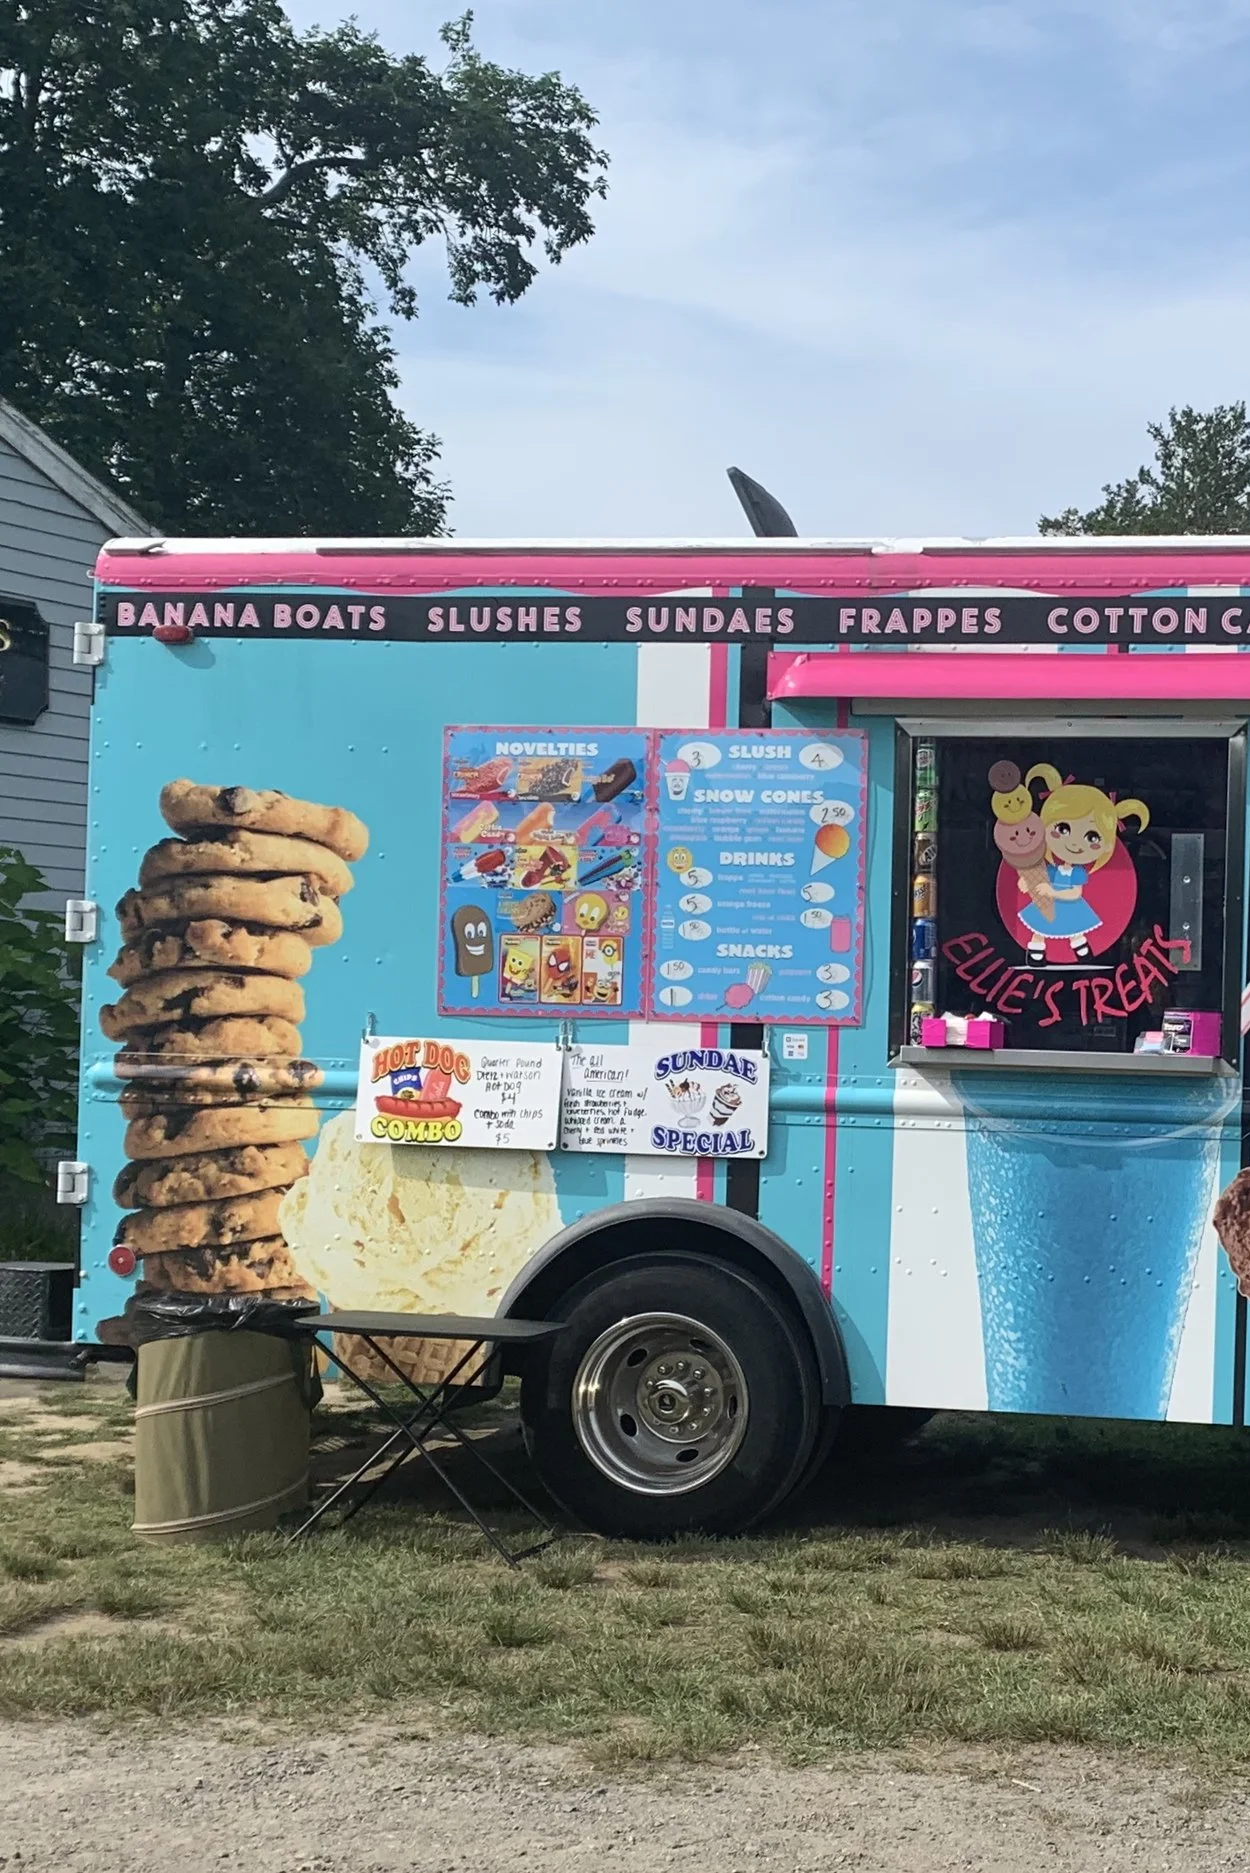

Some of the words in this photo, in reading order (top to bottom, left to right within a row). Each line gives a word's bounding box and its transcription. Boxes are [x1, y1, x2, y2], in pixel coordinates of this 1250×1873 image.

[117, 602, 260, 628] BANANA
[273, 604, 385, 631] BOATS
[427, 606, 582, 633] SLUSHES
[625, 607, 795, 634] SUNDAES
[839, 607, 1001, 634] FRAPPES
[1047, 607, 1207, 635] COTTON
[496, 742, 599, 757] NOVELTIES
[728, 745, 792, 760] SLUSH
[691, 751, 702, 767] 3
[810, 753, 825, 767] 4
[694, 789, 755, 803] SNOW
[761, 790, 825, 805] CONES
[719, 852, 795, 866] DRINKS
[687, 869, 699, 887] 5
[716, 943, 793, 959] SNACKS
[942, 932, 1064, 1027] ELLIE'S
[1072, 924, 1192, 1026] TREATS
[372, 1041, 420, 1082] HOT
[423, 1041, 470, 1083] DOG
[571, 1053, 586, 1067] The
[654, 1050, 758, 1083] SUNDAE
[393, 1073, 418, 1085] CHIPS
[501, 1092, 516, 1105] $4
[371, 1116, 462, 1142] COMBO
[495, 1132, 511, 1146] $5
[652, 1127, 754, 1155] SPECIAL
